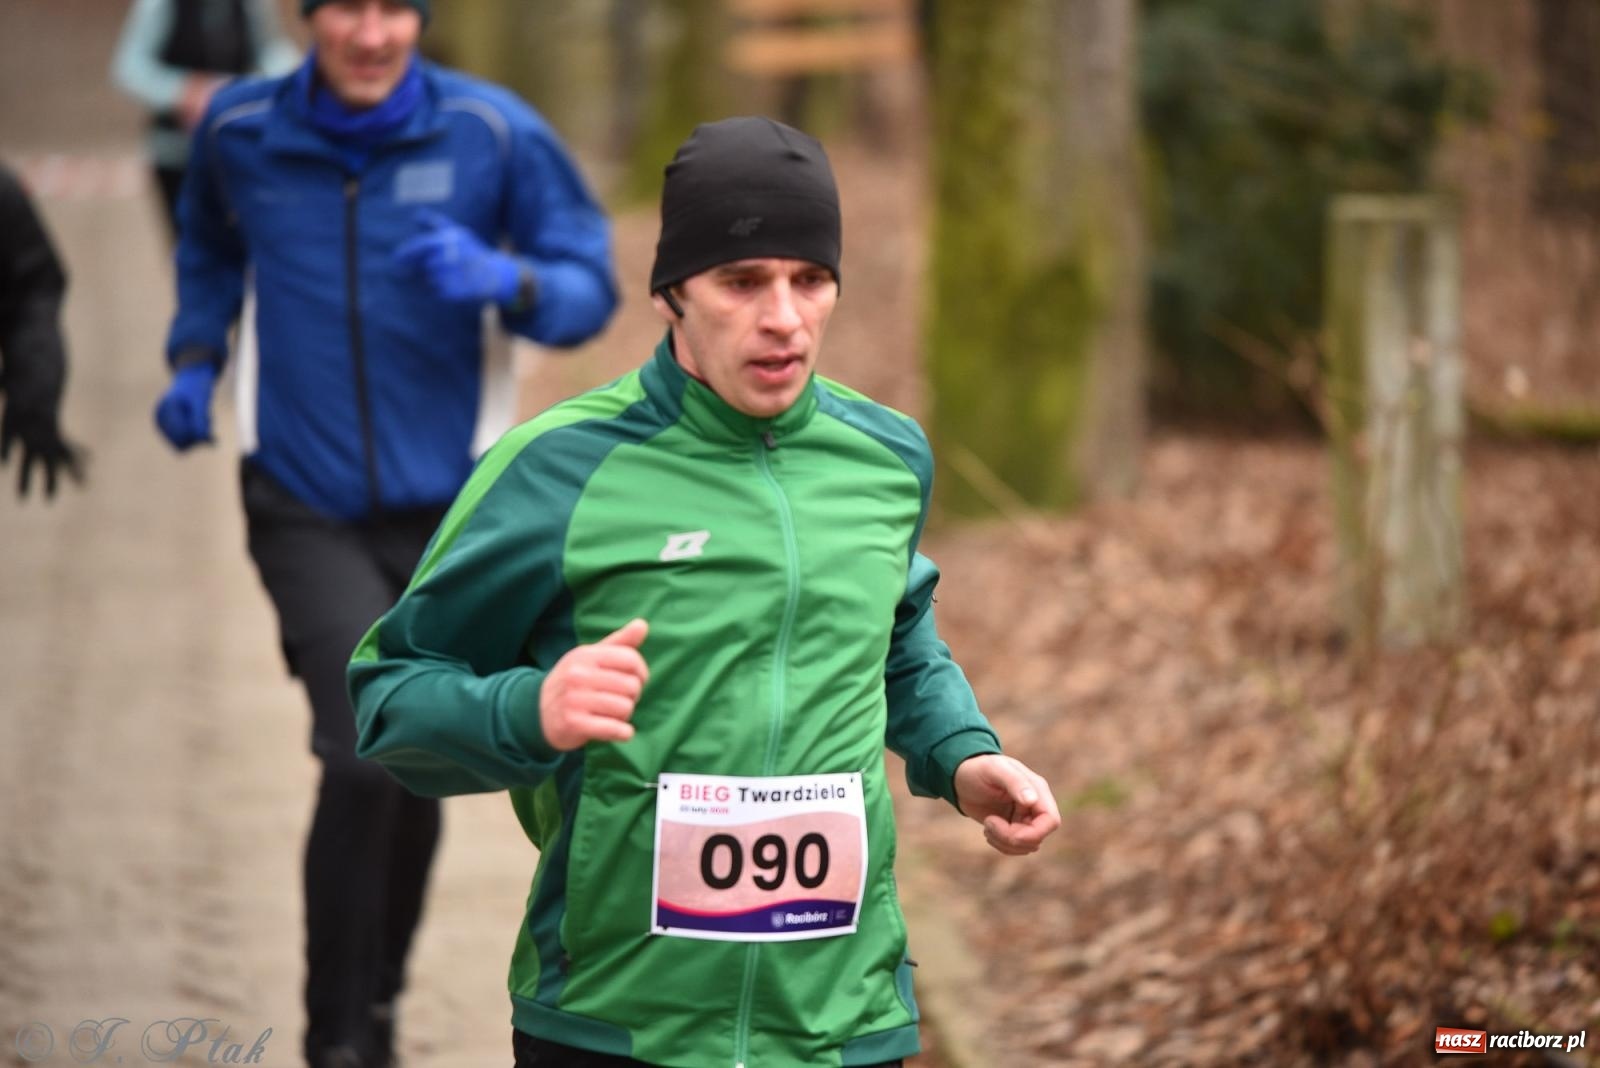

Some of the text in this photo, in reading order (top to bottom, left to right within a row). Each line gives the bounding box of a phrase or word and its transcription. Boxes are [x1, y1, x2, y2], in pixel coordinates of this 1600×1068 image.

[680, 783, 847, 803] BIEG Twardziela
[701, 832, 829, 891] 090
